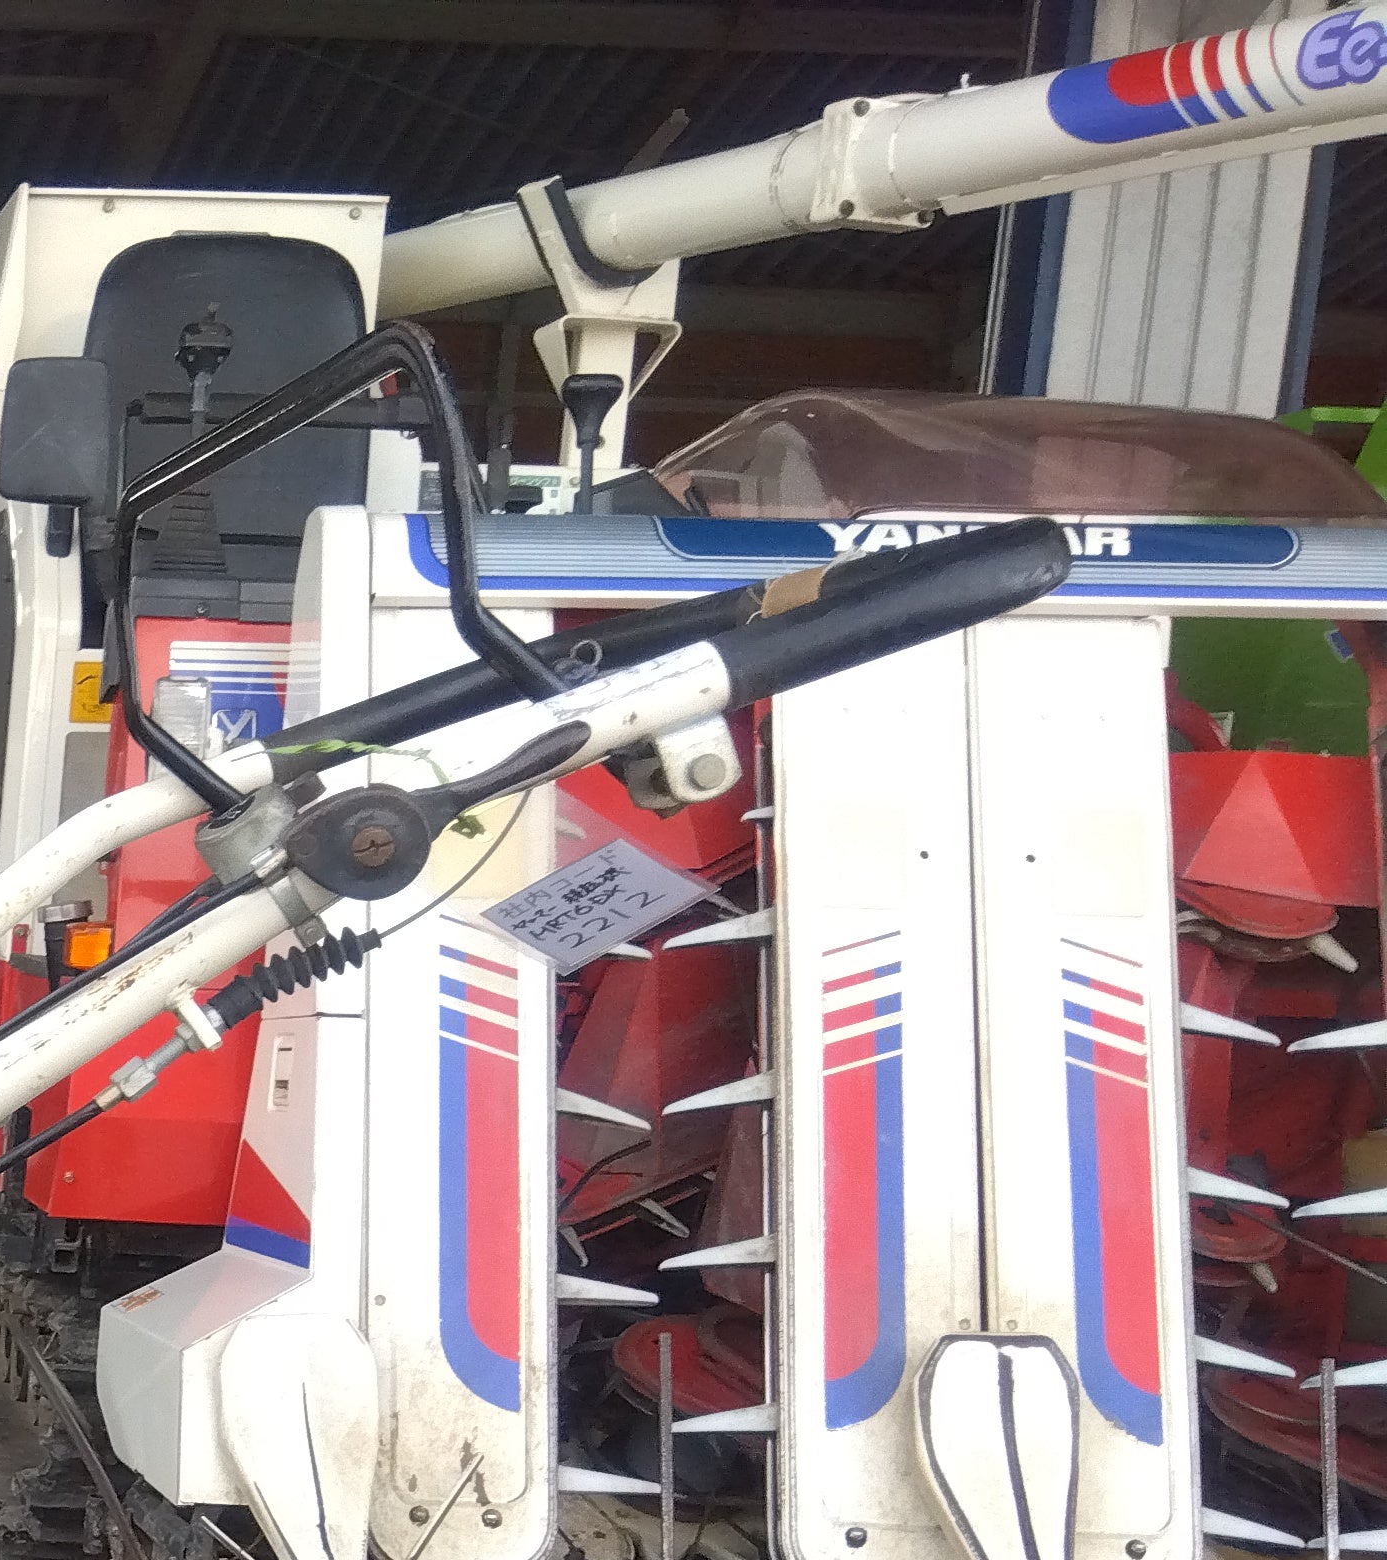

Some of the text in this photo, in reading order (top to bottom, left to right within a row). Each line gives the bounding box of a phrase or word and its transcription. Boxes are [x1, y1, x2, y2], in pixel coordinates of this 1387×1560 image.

[1297, 9, 1387, 90] Ee
[819, 523, 1131, 556] YANR
[499, 850, 616, 918] 社内コード
[559, 891, 666, 949] 2212
